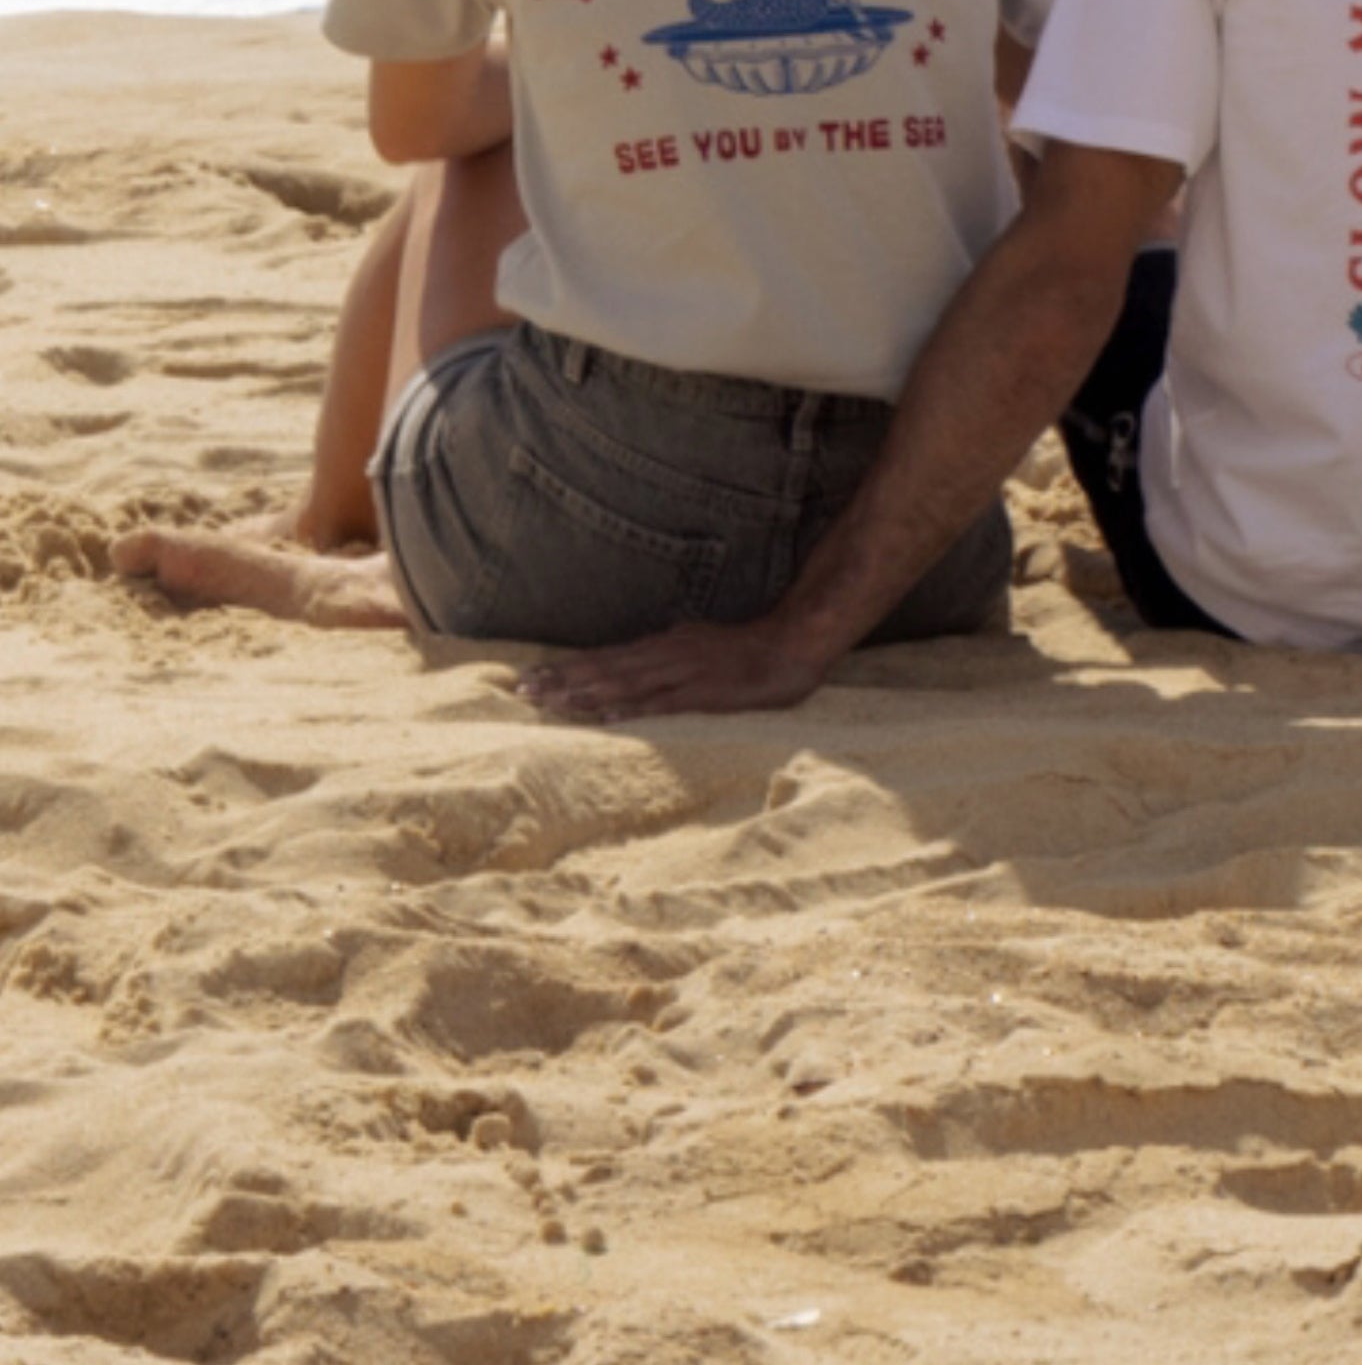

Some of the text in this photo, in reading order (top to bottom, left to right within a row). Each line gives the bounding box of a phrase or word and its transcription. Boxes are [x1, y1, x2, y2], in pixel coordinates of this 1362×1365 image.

[614, 116, 947, 175] SEE YOU BY THE SEA
